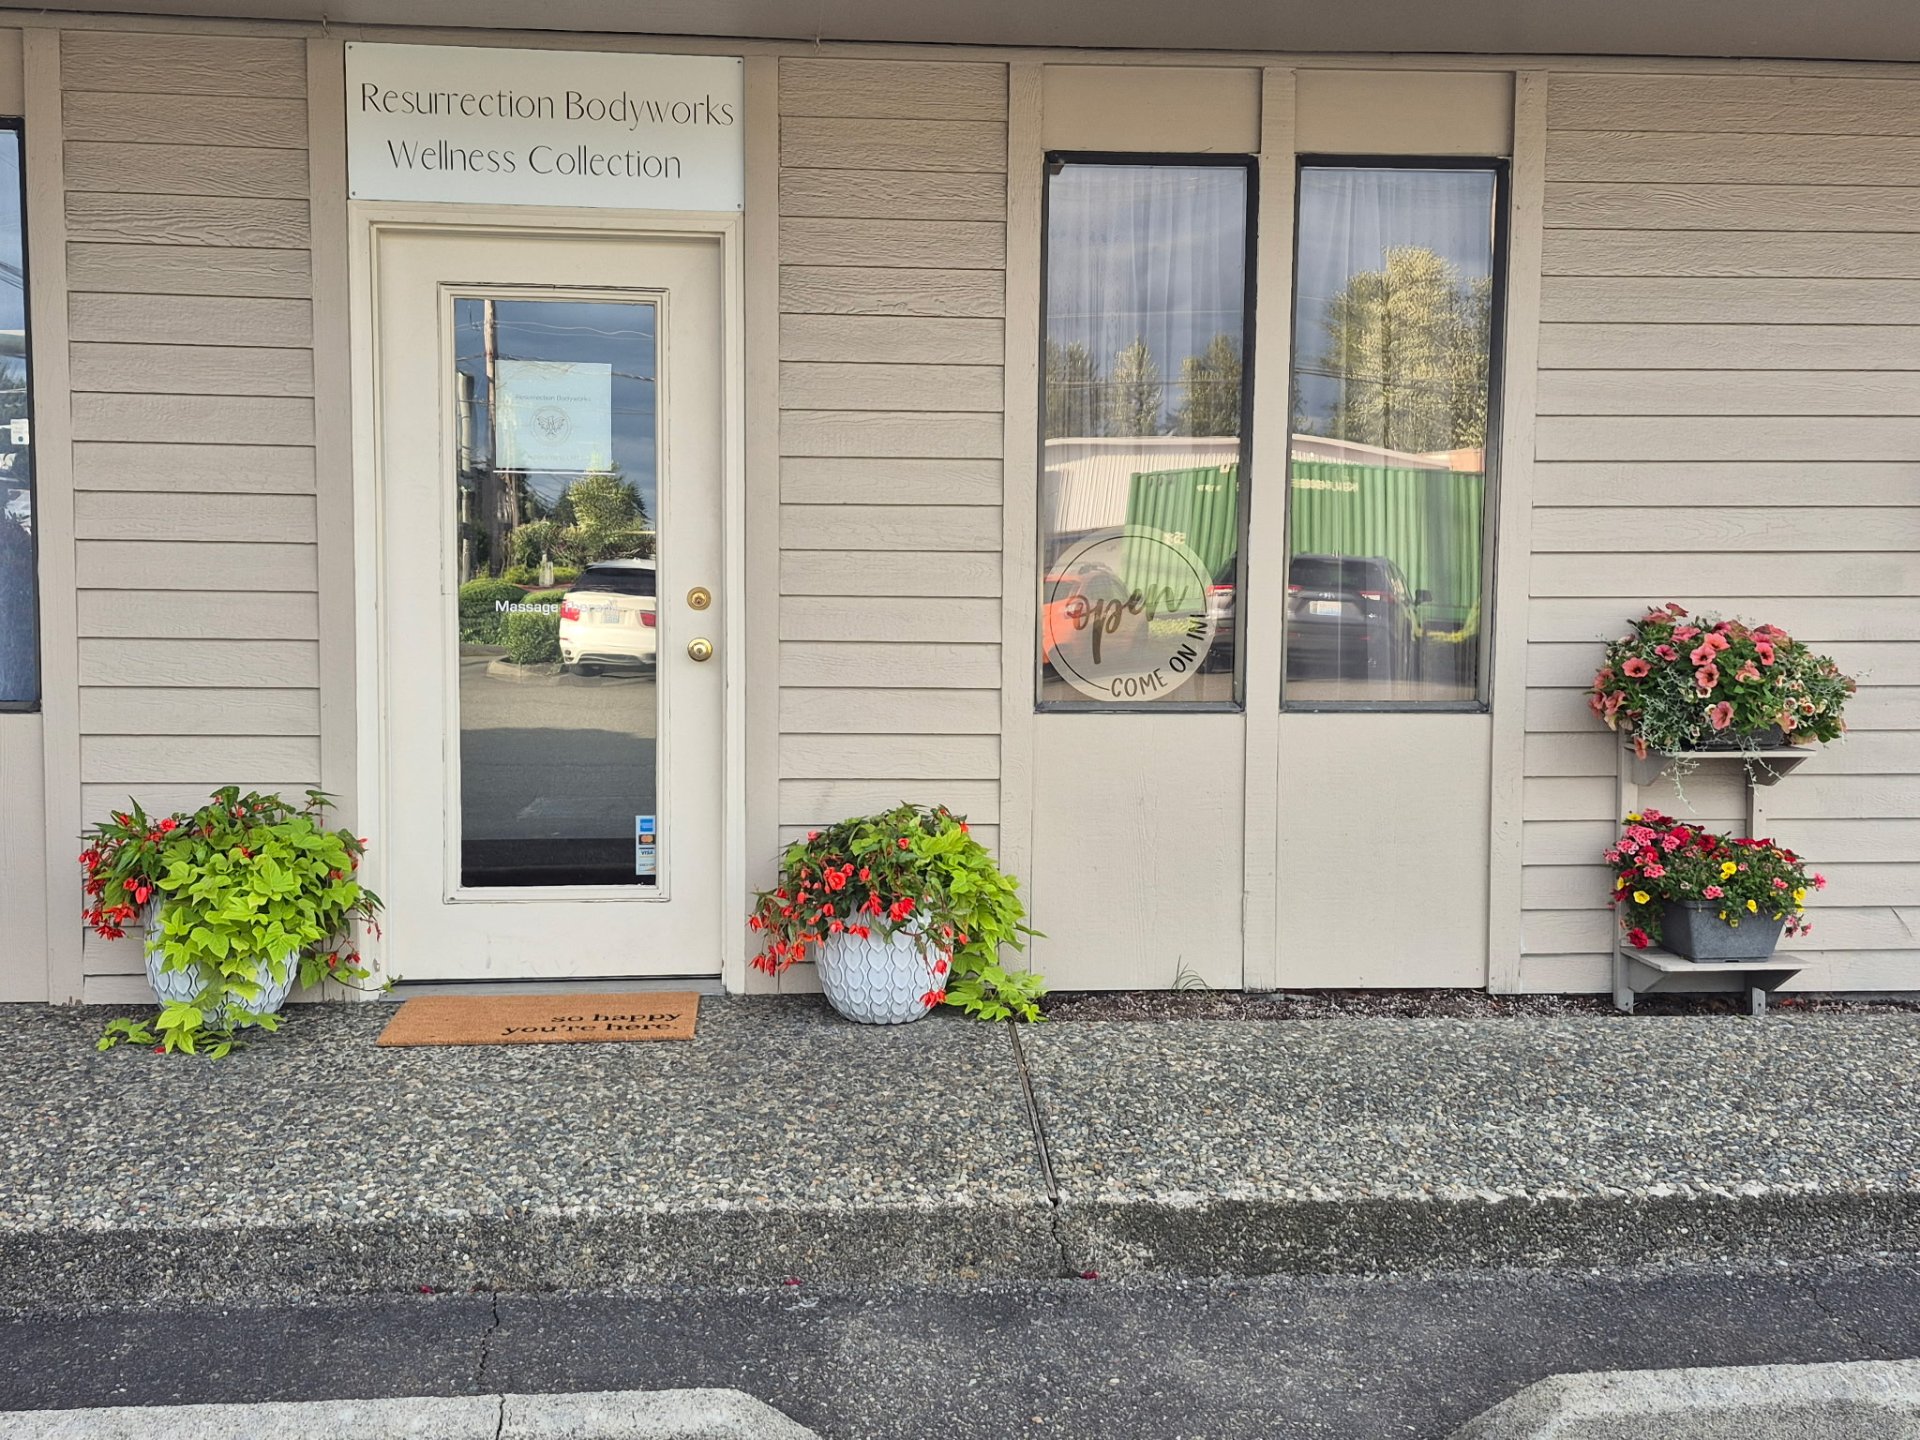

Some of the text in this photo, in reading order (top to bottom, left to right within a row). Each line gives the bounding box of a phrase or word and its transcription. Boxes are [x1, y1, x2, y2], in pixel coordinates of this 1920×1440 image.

[361, 82, 734, 131] Resurrection Bodyworks
[387, 139, 681, 179] Wellness Collection
[495, 600, 617, 616] Massage Thera
[1066, 584, 1189, 664] open
[1111, 613, 1209, 698] COME ON IN!
[501, 1023, 678, 1036] you're here.
[593, 1013, 682, 1022] happy
